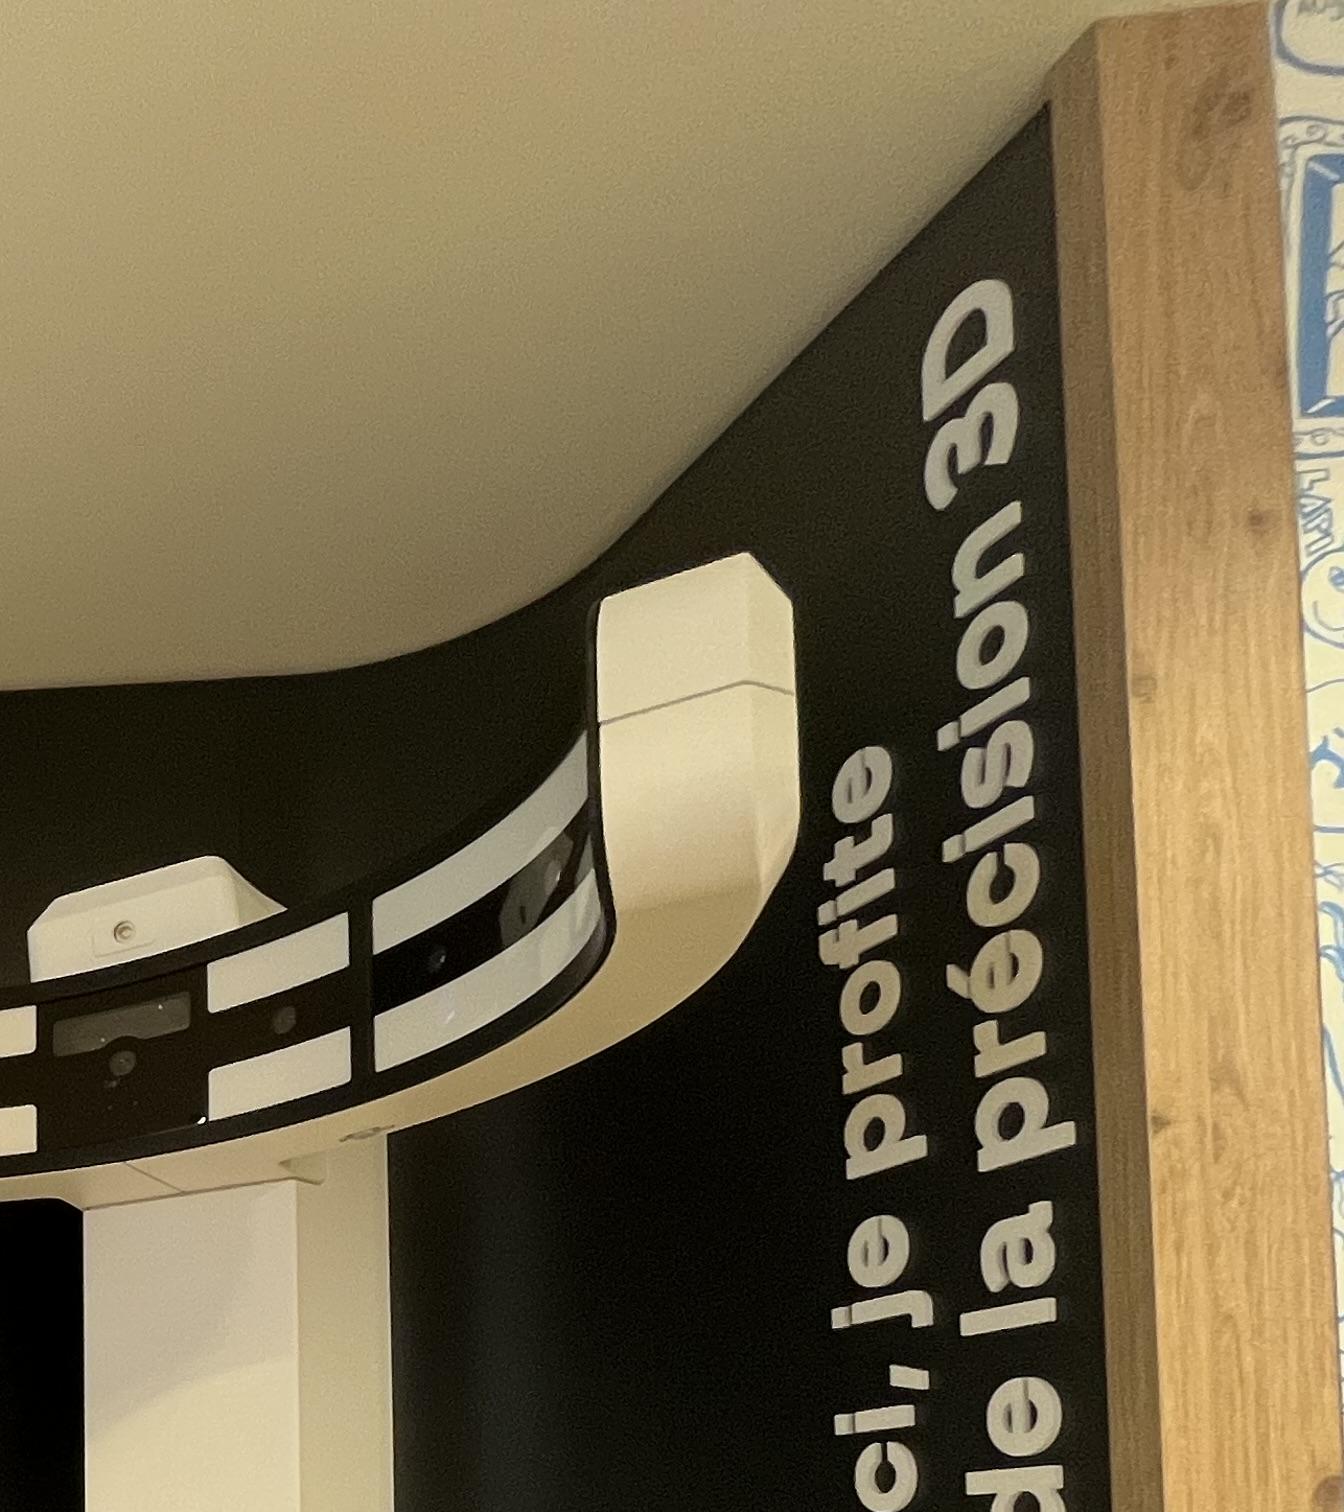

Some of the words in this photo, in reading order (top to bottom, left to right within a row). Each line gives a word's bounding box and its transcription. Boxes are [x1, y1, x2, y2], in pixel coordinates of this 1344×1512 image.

[920, 278, 1021, 511] 3D
[936, 499, 1077, 1173] précision
[817, 745, 928, 1181] profite
[830, 1214, 935, 1330] je
[959, 1200, 1057, 1337] la
